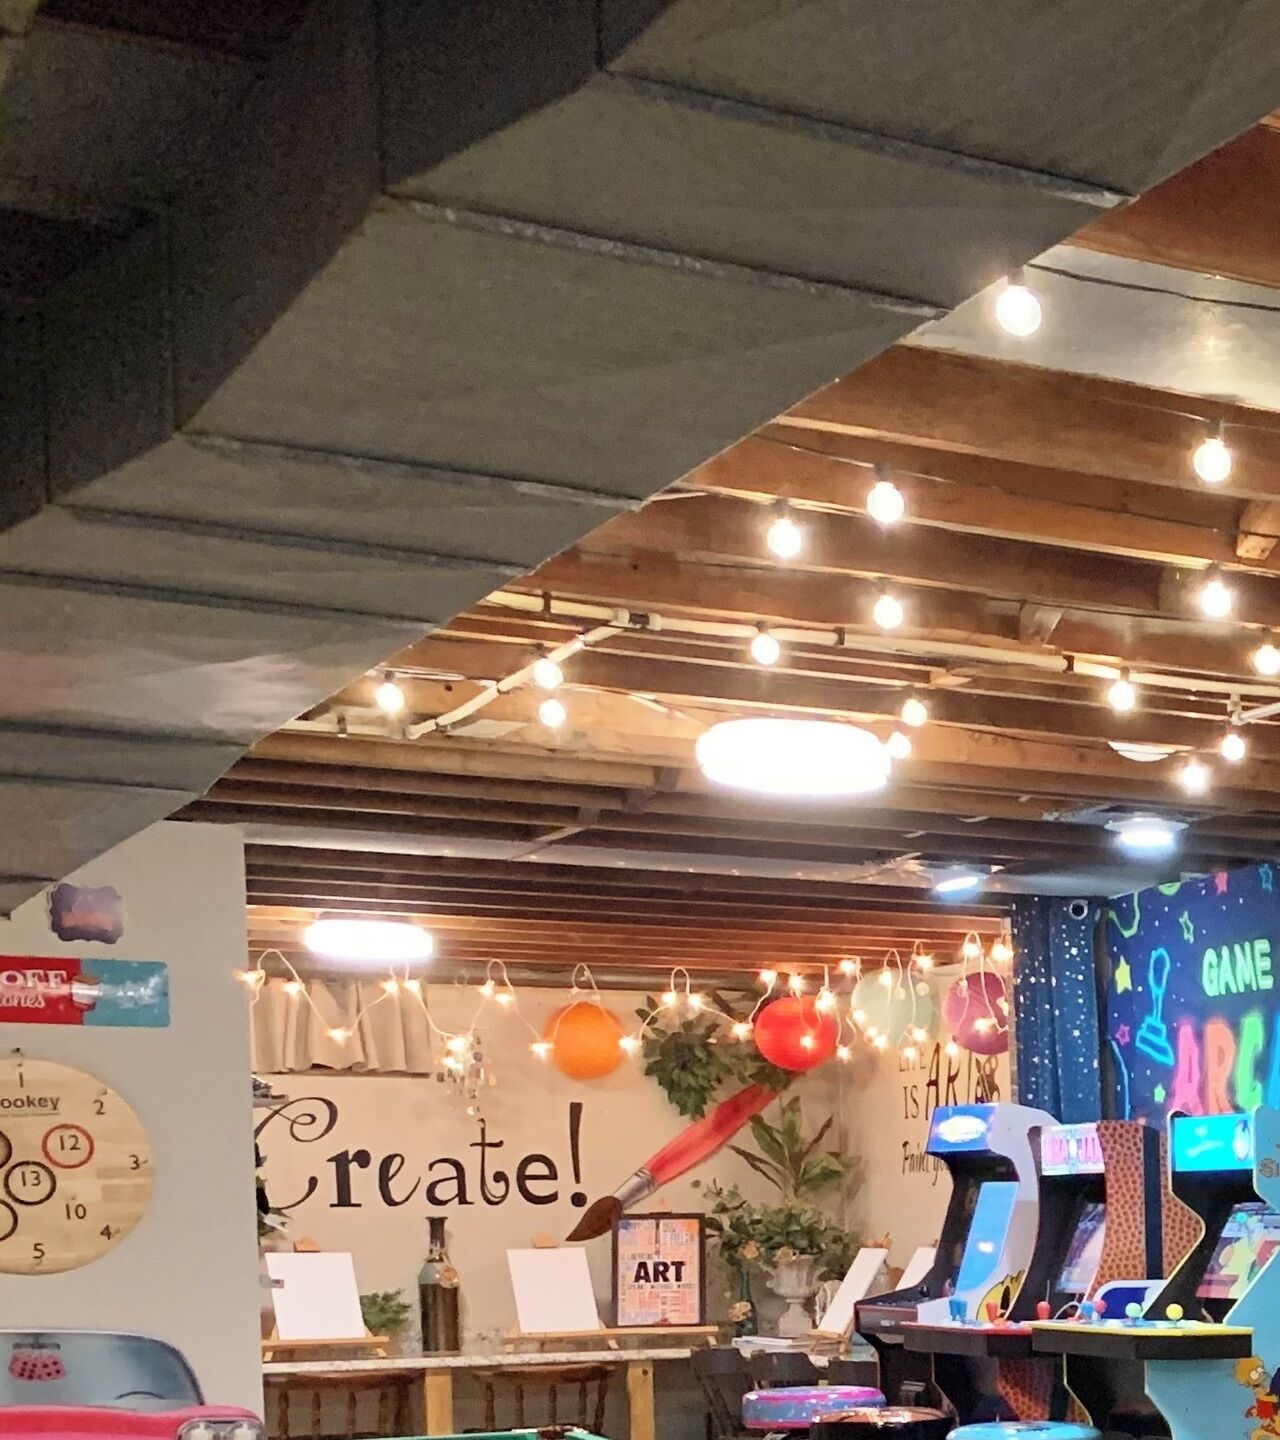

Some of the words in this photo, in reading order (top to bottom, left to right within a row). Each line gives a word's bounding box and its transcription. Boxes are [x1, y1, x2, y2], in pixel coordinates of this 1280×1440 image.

[1202, 938, 1274, 997] GAME
[0, 969, 68, 989] OFF
[0, 1095, 60, 1111] ookey
[93, 1100, 106, 1115] 2
[902, 1084, 920, 1120] IS
[59, 1134, 81, 1151] 12
[254, 1096, 588, 1209] Create!
[128, 1154, 141, 1170] 3
[21, 1170, 42, 1187] 13
[65, 1203, 87, 1220] 10
[100, 1224, 112, 1240] 4
[33, 1243, 45, 1259] 5
[633, 1260, 686, 1283] ART
